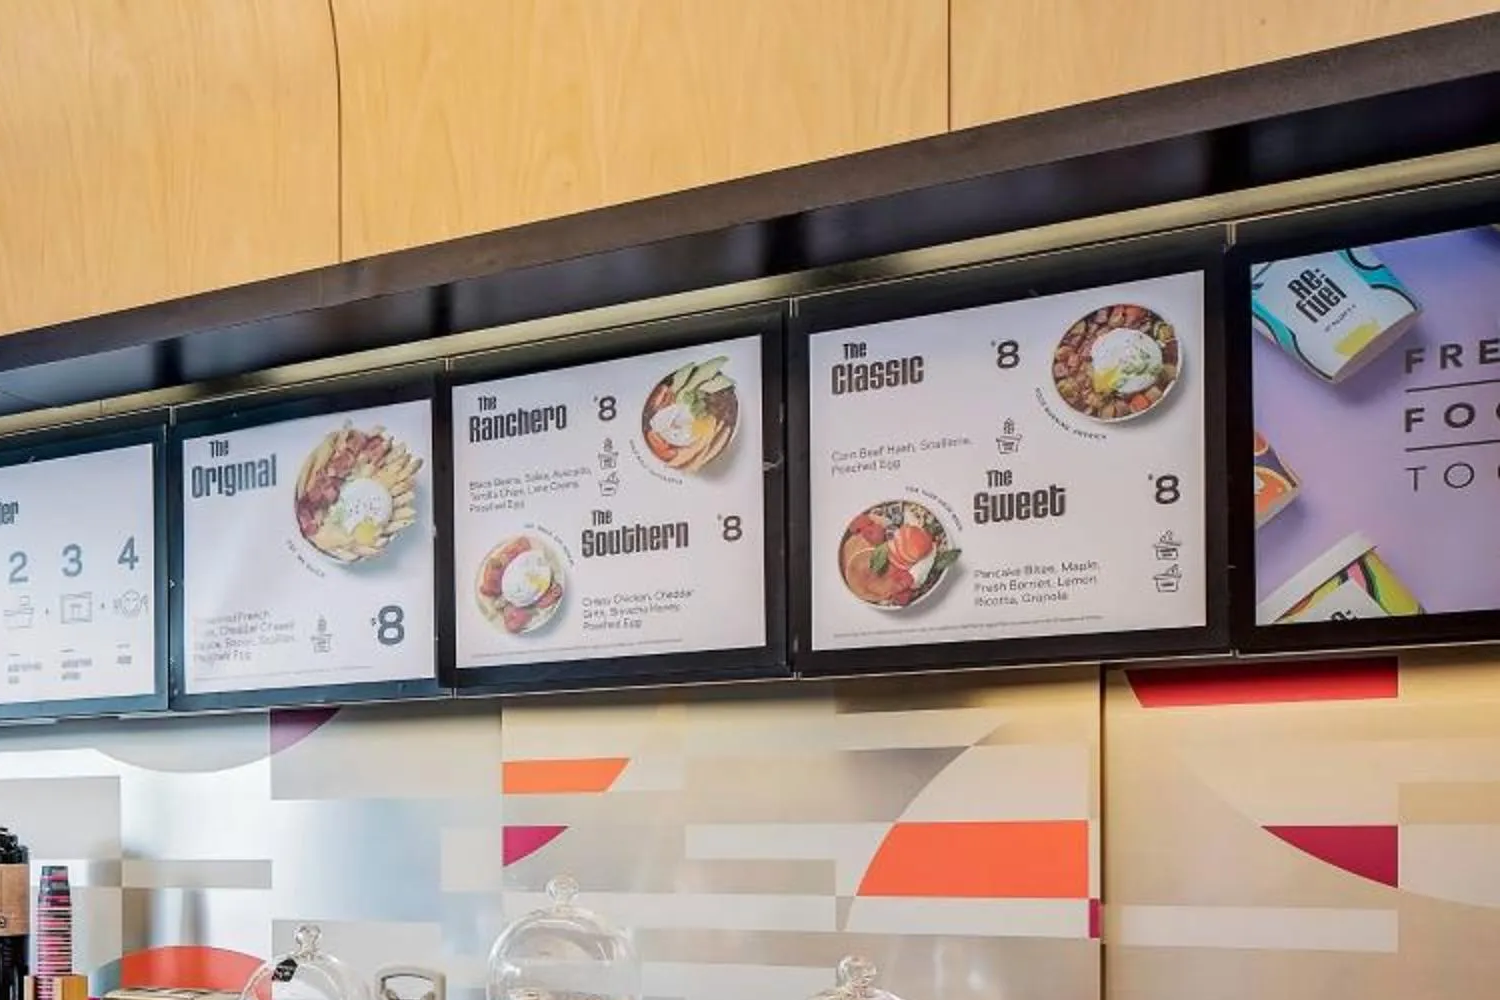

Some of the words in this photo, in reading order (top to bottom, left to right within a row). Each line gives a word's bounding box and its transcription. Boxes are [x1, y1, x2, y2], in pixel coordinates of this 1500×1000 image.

[1287, 267, 1327, 301] Re:
[1295, 276, 1348, 324] fuel
[843, 341, 867, 360] The
[1404, 337, 1500, 375] FRE
[831, 355, 925, 396] Classic
[477, 395, 497, 412] The
[1404, 402, 1500, 433] FO
[469, 404, 567, 443] Ranchero
[208, 439, 229, 459] The
[191, 453, 277, 498] Original
[986, 469, 1013, 489] The
[592, 509, 613, 526] The
[973, 483, 1066, 525] Sweet
[581, 521, 689, 558] Southern
[8, 551, 29, 584] 2
[61, 543, 83, 578] 3
[117, 535, 140, 571] 4
